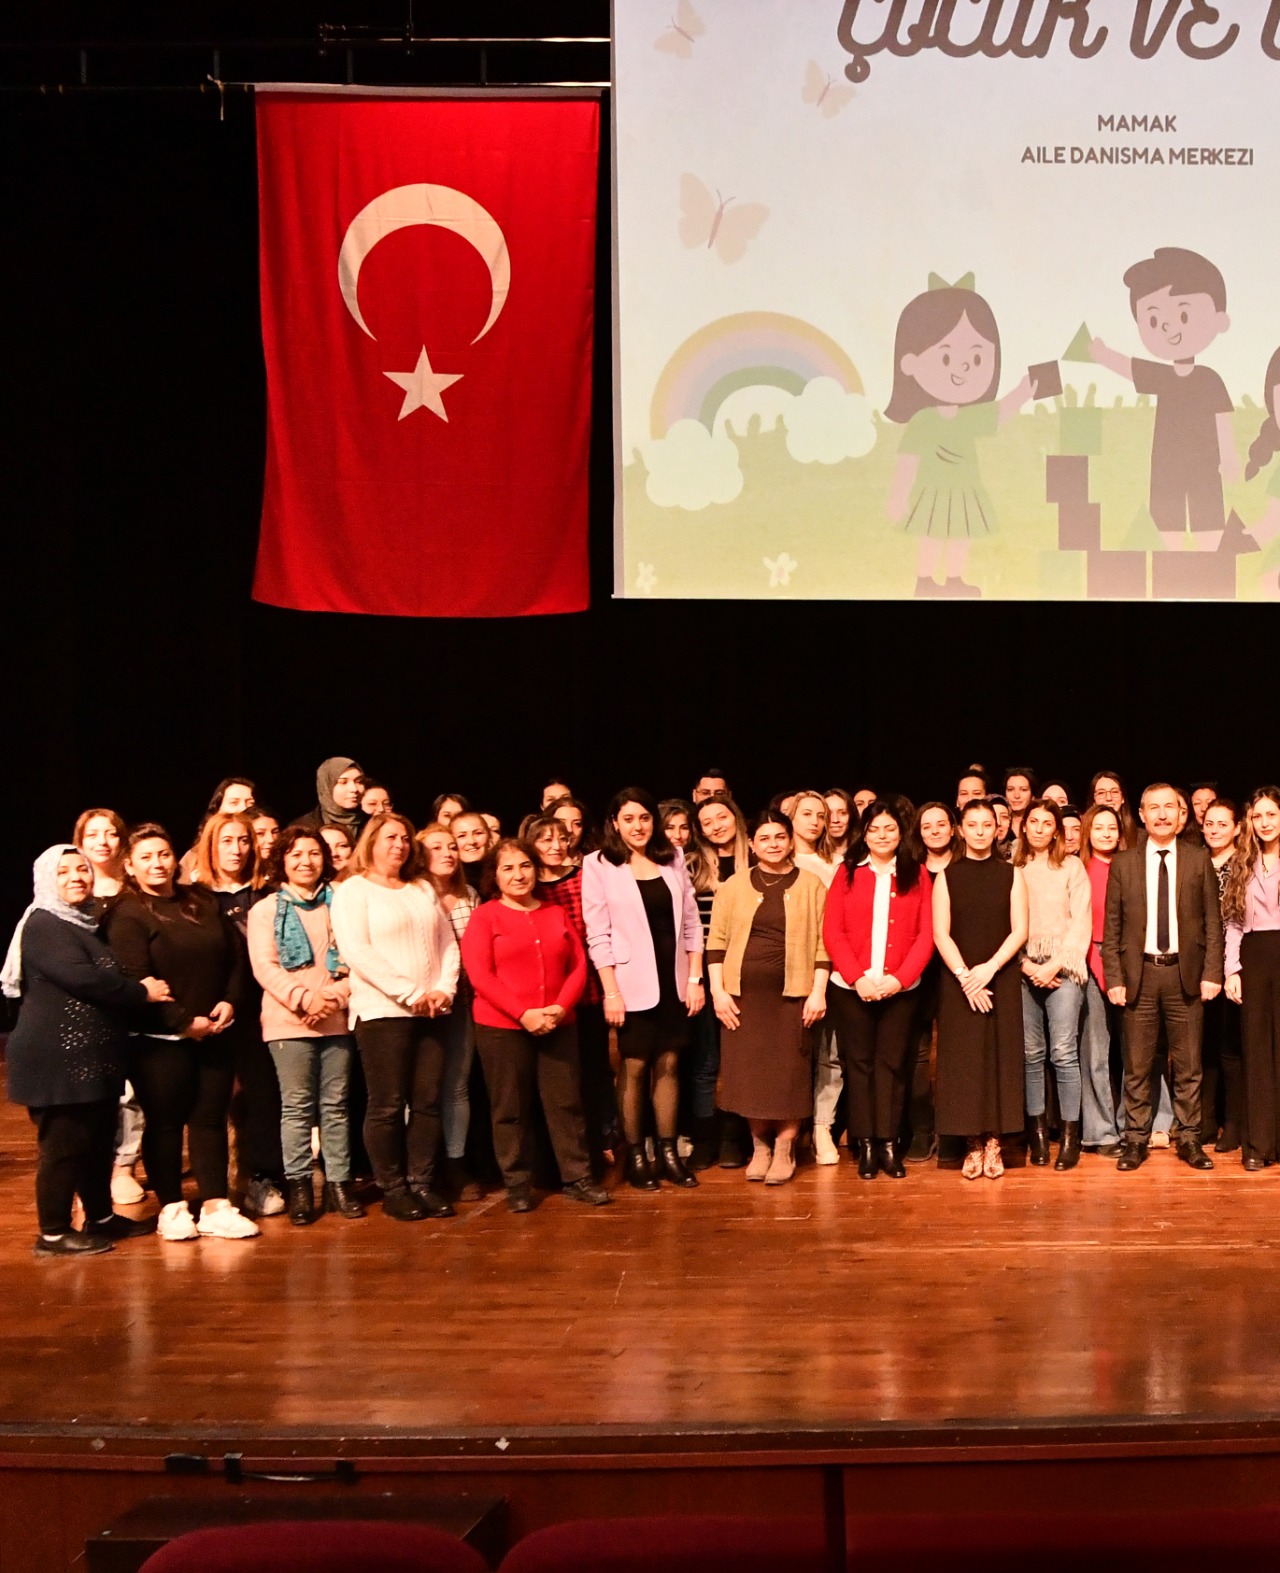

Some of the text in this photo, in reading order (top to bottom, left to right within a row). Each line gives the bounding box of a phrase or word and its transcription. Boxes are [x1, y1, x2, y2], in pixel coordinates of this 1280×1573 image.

[1129, 0, 1240, 60] VE
[1097, 114, 1177, 133] MAMAK
[1021, 146, 1254, 166] AILE DANISMA MERKEZI
